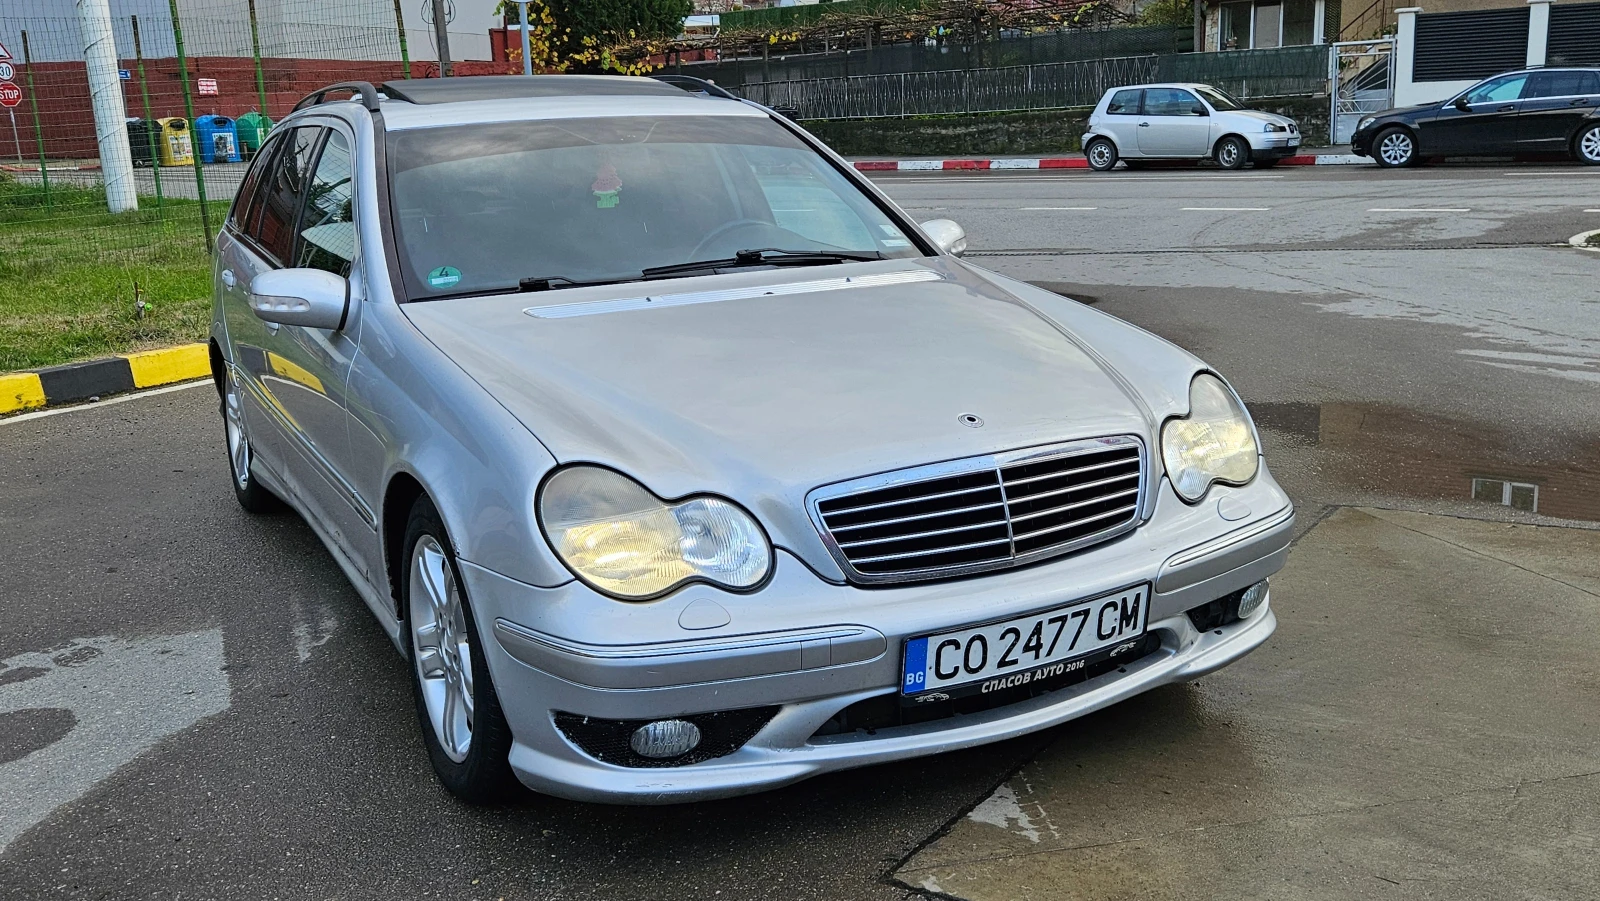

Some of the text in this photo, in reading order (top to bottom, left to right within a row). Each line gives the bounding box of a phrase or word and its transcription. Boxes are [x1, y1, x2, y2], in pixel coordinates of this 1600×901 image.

[0, 66, 11, 77] 30
[0, 89, 19, 100] STOP
[439, 266, 449, 277] 4
[934, 592, 1141, 680] CO 2477 CM
[906, 672, 924, 685] BG
[981, 660, 1085, 693] СПАСОВ АУТО 2016
